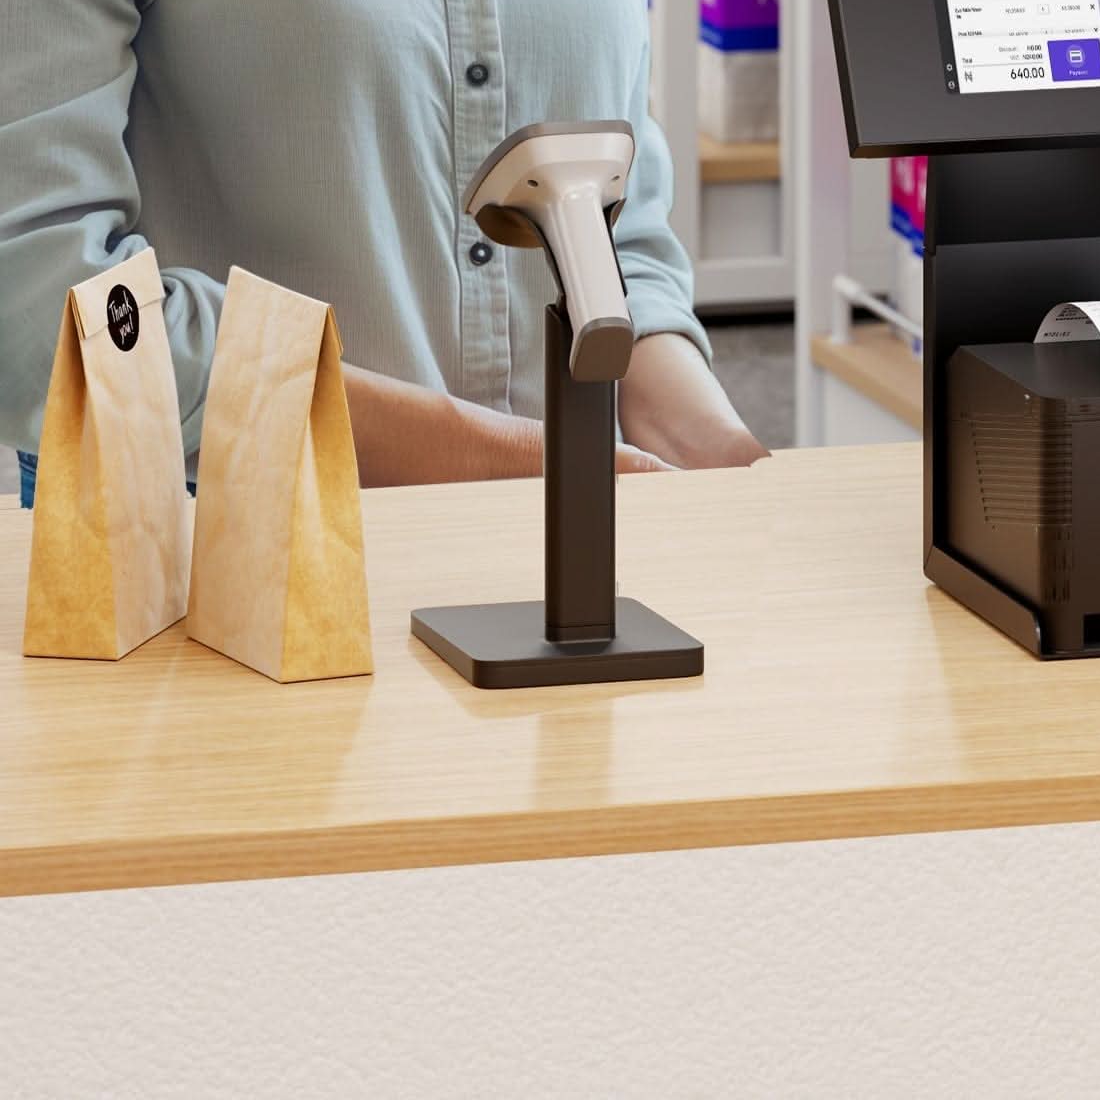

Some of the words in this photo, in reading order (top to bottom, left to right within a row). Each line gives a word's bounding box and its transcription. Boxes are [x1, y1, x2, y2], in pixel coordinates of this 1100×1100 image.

[1010, 66, 1045, 80] 640.00
[109, 290, 133, 323] Thank
[119, 313, 135, 345] you!
